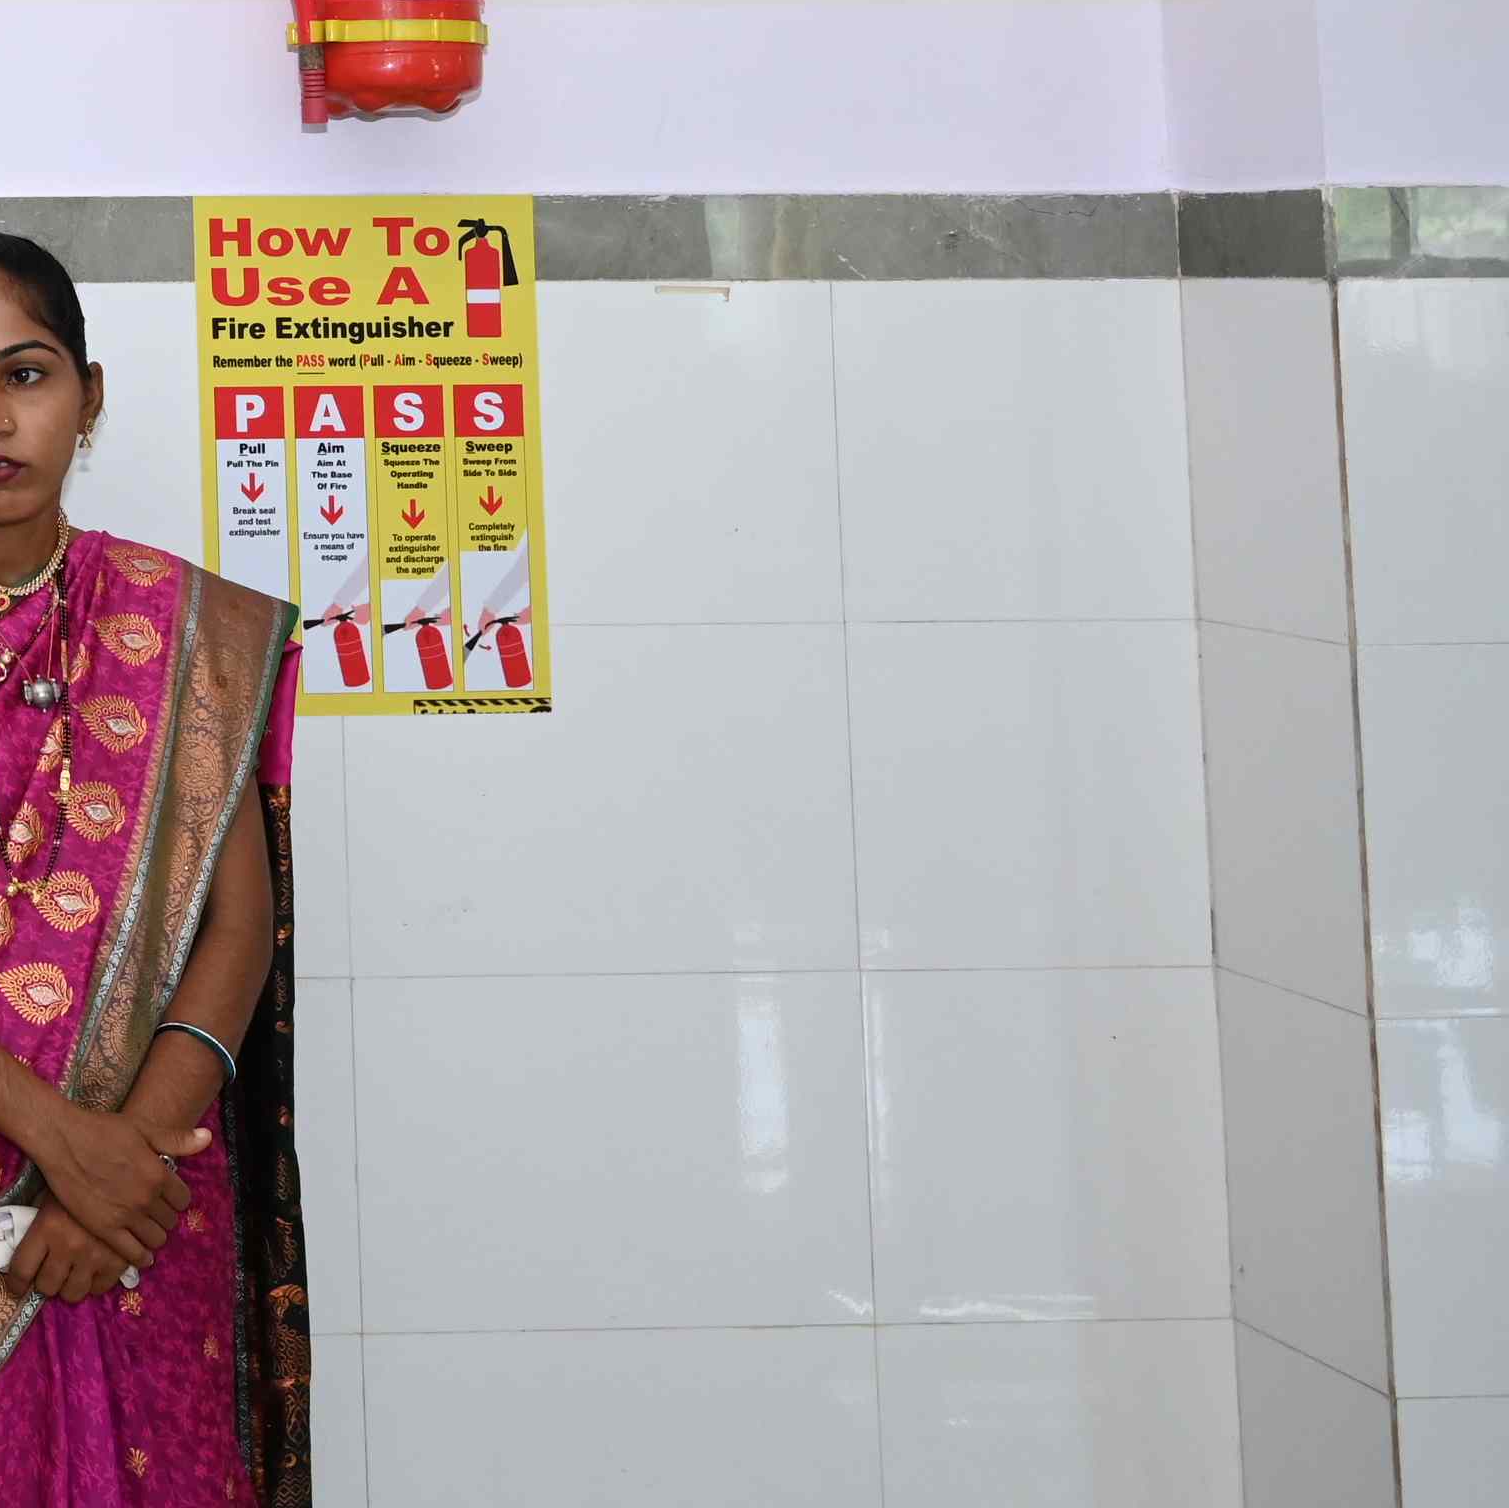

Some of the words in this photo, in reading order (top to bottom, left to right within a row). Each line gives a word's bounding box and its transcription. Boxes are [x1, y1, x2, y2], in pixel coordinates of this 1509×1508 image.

[209, 218, 352, 257] How
[372, 217, 451, 257] To
[210, 267, 352, 307] Use
[376, 266, 430, 306] A
[211, 317, 266, 339] Fire
[275, 316, 454, 345] Extinguisher
[212, 355, 273, 368] Remember
[275, 355, 293, 368] the
[296, 354, 325, 367] PASS
[328, 354, 356, 367] word
[359, 353, 384, 370] (Pull
[394, 354, 416, 366] Aim
[425, 353, 472, 369] Squeeze
[482, 352, 523, 369] Sweep)
[235, 394, 265, 433] P
[309, 393, 346, 432] A
[393, 392, 425, 432] S
[473, 391, 505, 431] S
[239, 443, 266, 454] Pull
[317, 442, 345, 453] Aim
[381, 441, 441, 455] Squeeze
[465, 440, 513, 455] Sweep
[383, 458, 421, 467] Squeeze
[423, 458, 440, 466] The
[462, 458, 492, 466] Sweep
[311, 471, 328, 479] The
[390, 470, 434, 479] Operating
[463, 469, 482, 477] Side
[484, 469, 496, 477] To
[498, 469, 518, 477] Side
[232, 507, 257, 515] Break
[258, 507, 276, 515] seal
[468, 523, 515, 532] Completely
[229, 529, 281, 538] extinguisher
[303, 532, 329, 540] Ensure
[331, 533, 345, 541] you
[470, 533, 514, 542] extinguish
[404, 534, 437, 543] operate
[346, 542, 354, 550] of
[389, 544, 441, 554] extinguisher
[321, 554, 348, 562] escape
[403, 555, 445, 565] discharge
[396, 566, 410, 574] the
[411, 566, 435, 576] agent
